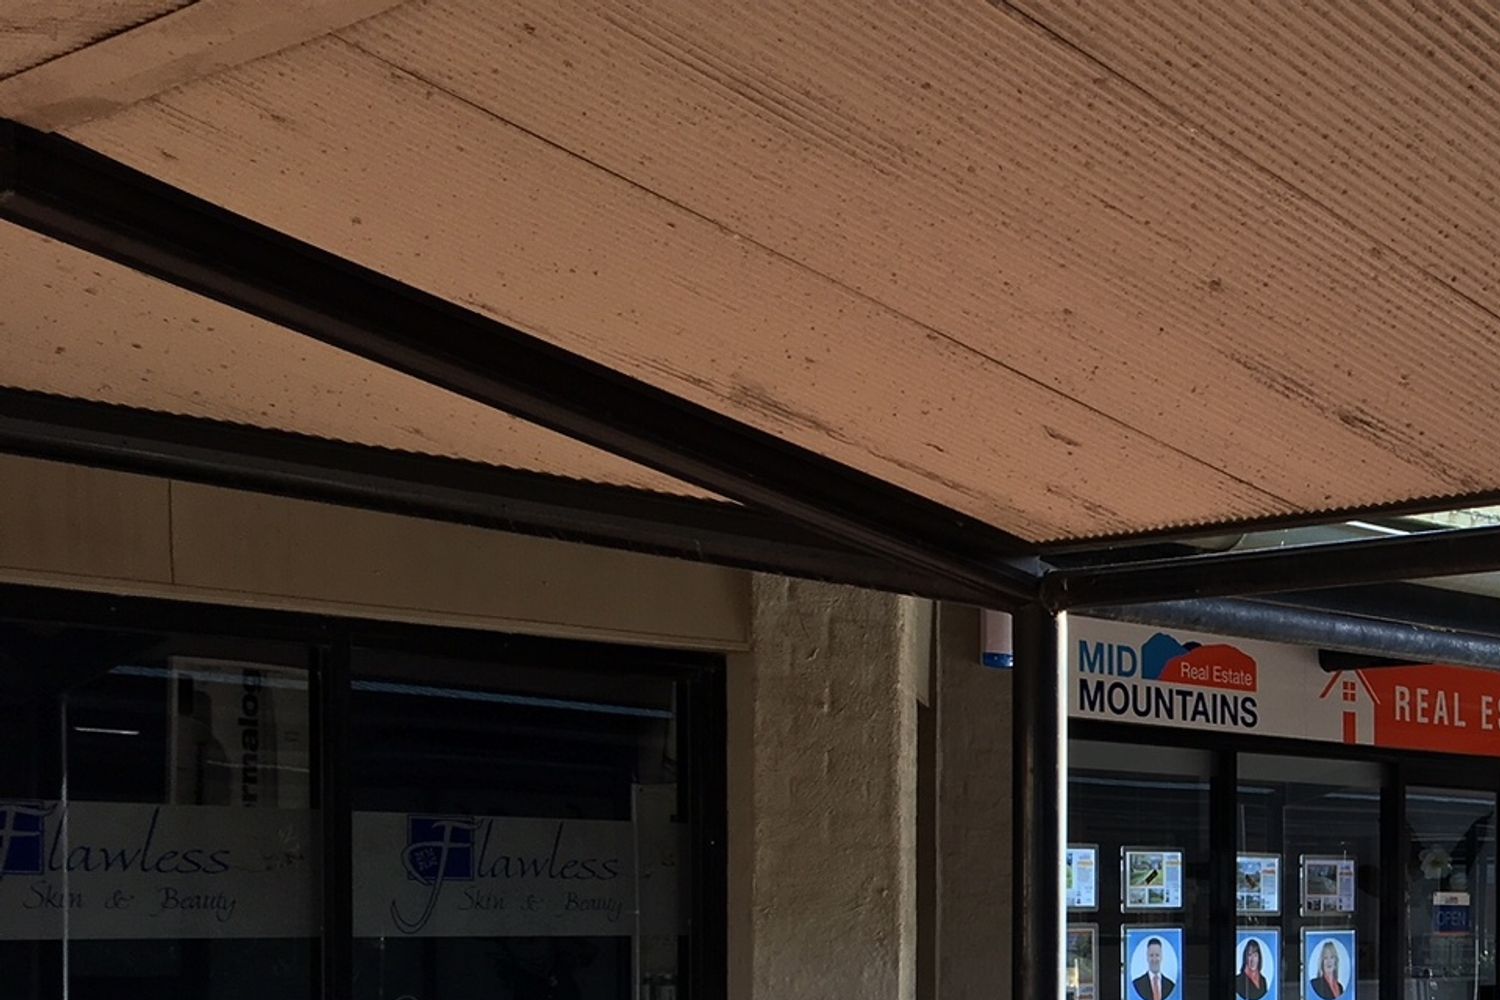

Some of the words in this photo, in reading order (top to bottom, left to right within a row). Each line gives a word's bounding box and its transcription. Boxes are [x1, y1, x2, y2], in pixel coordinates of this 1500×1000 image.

[1078, 639, 1137, 678] MID
[1180, 661, 1209, 680] Real
[1212, 665, 1253, 687] Estate
[1078, 678, 1259, 728] MOUNTAINS
[1394, 685, 1467, 728] REAL
[23, 881, 82, 910] Skin
[105, 889, 134, 910] &
[150, 885, 237, 922] Beauty
[457, 886, 506, 911] Skin
[519, 893, 540, 912] &
[555, 890, 623, 922] Beauty
[1436, 910, 1467, 927] OPEN
